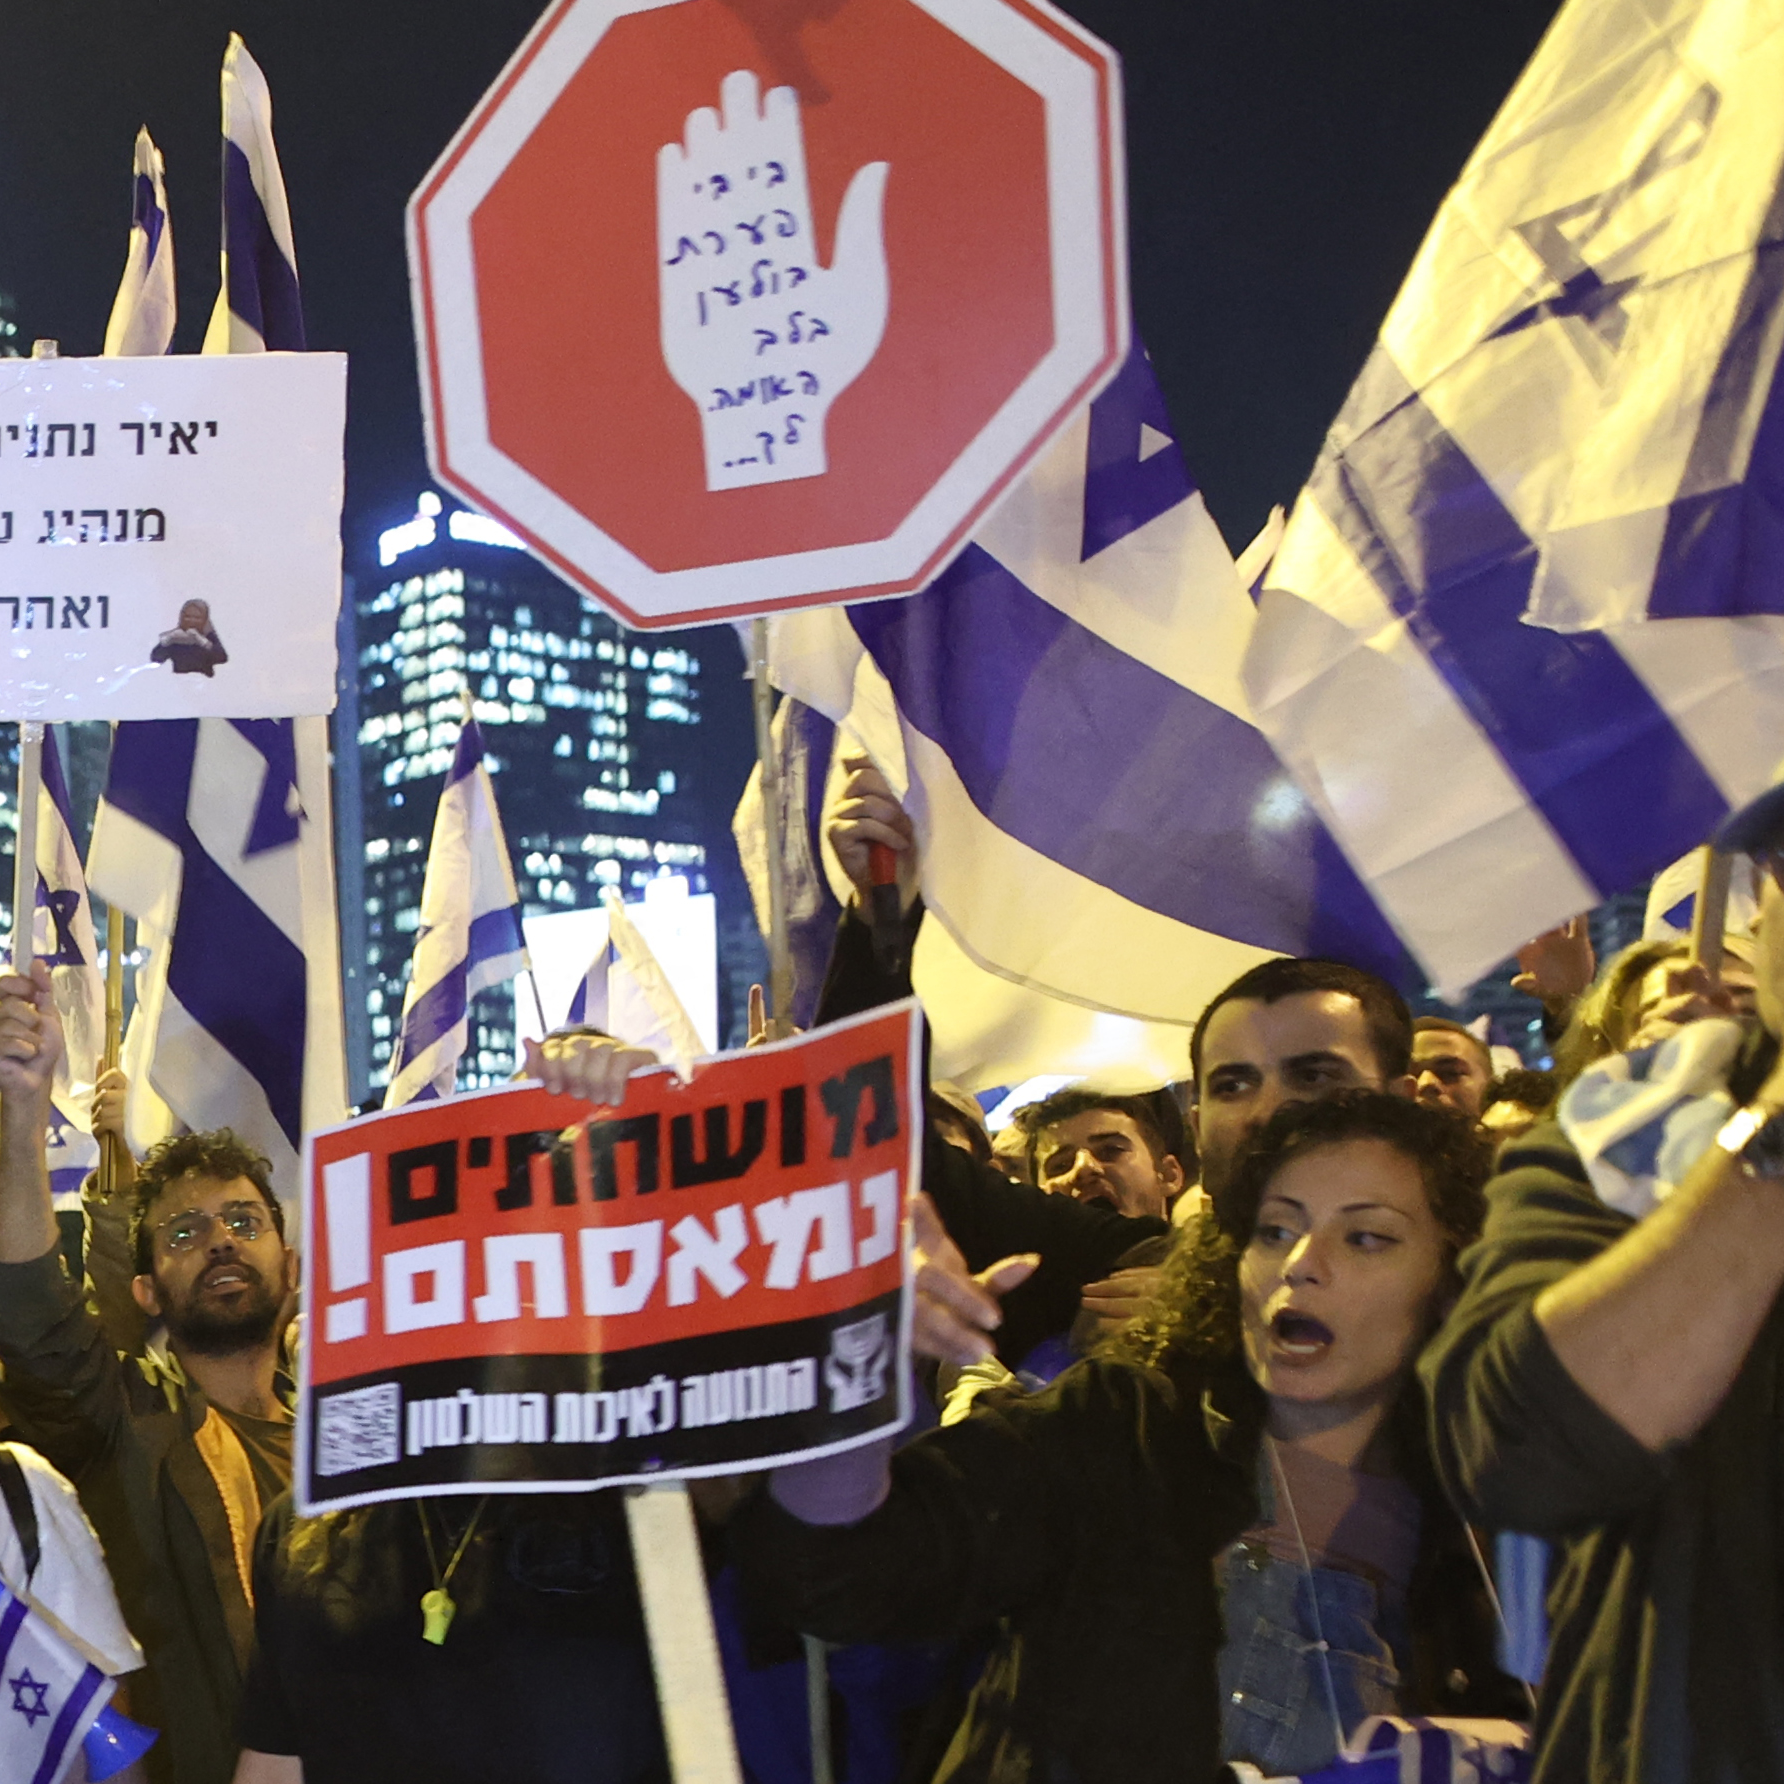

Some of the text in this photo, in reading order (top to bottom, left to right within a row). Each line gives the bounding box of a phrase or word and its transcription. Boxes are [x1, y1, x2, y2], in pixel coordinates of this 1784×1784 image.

[753, 311, 829, 356] בלב
[120, 420, 219, 456] יאיר
[36, 507, 167, 545] מנהיג
[389, 1055, 900, 1226] מושחתים
[322, 1151, 899, 1343] נמאסתם!
